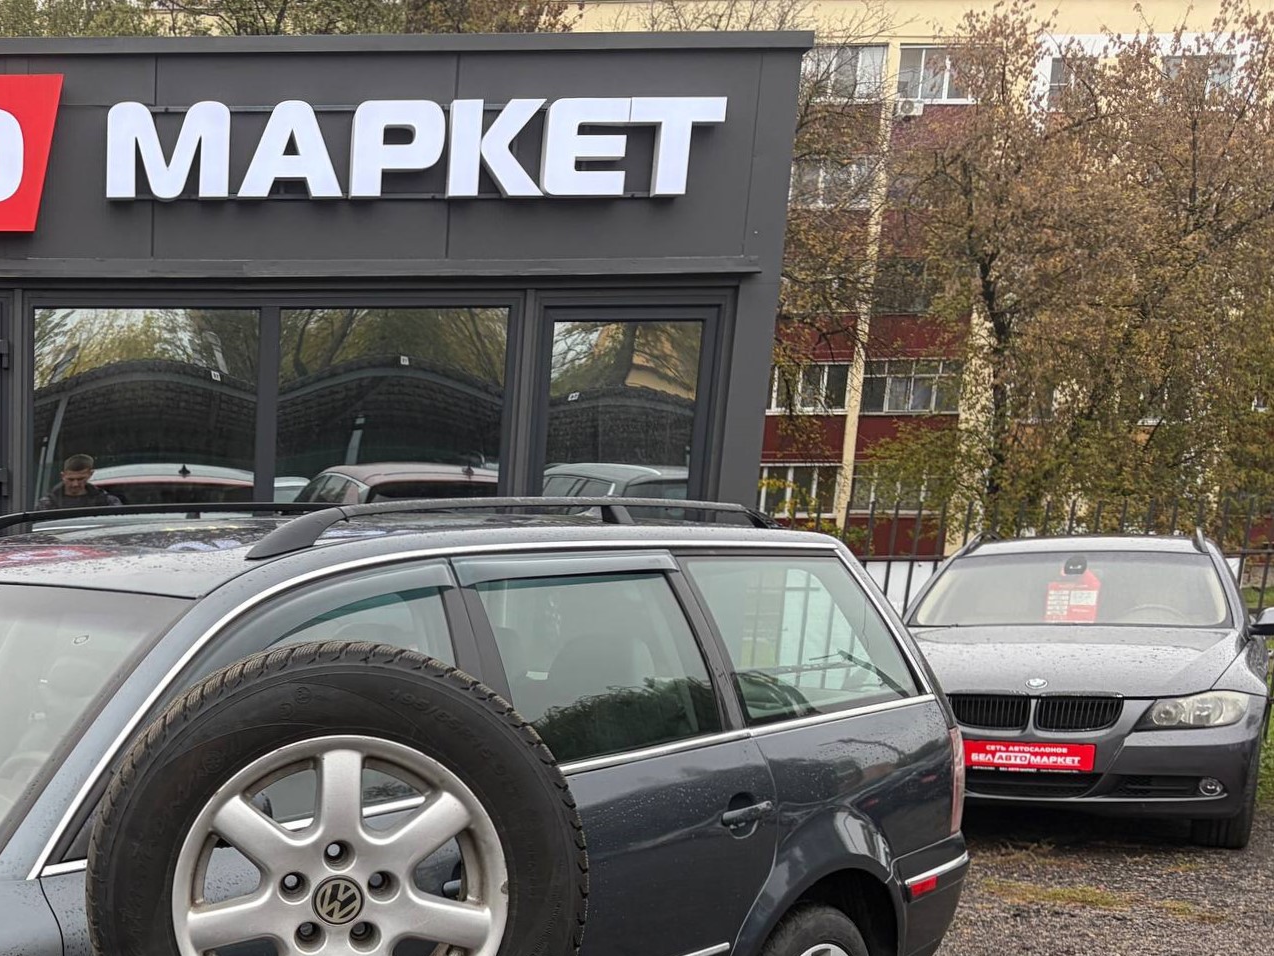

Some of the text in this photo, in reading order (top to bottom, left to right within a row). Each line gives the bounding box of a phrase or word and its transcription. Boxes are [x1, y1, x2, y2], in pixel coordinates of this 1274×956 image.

[106, 96, 728, 200] МАРКЕТ
[1008, 745, 1068, 753] АВТОСАЛОНОВ
[971, 753, 1081, 765] БЕЛ АВТО МАРКЕТ
